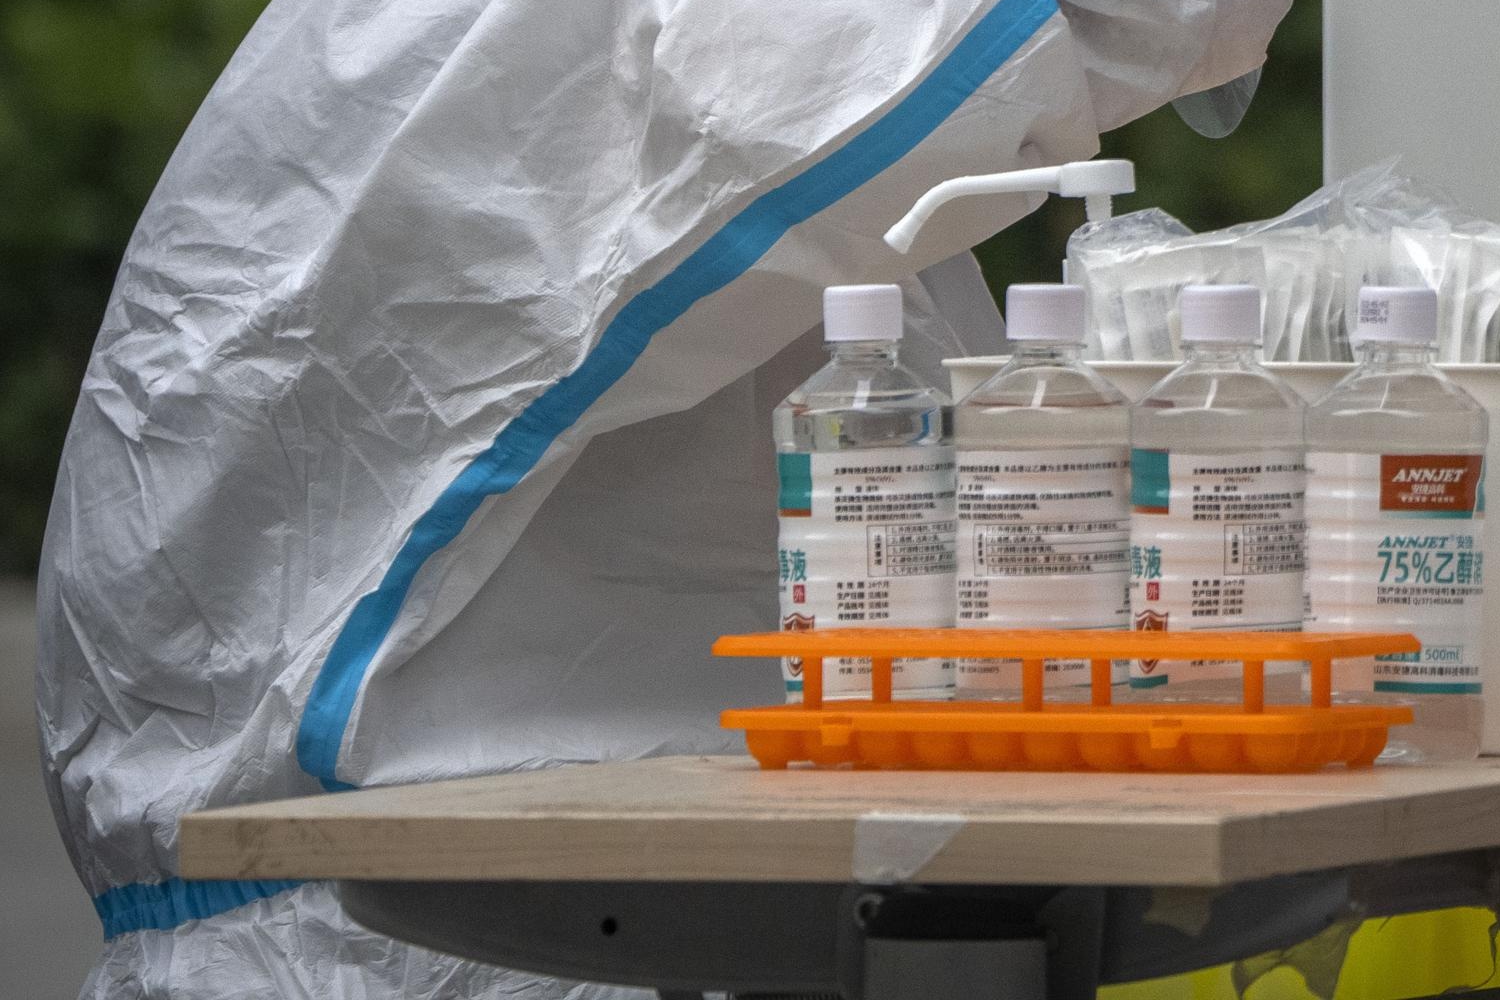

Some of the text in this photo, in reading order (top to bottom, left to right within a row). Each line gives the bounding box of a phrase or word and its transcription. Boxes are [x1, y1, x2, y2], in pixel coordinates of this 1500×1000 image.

[1391, 468, 1465, 482] ANNJET
[1378, 536, 1449, 549] ANNJET
[1425, 648, 1460, 662] 500ml
